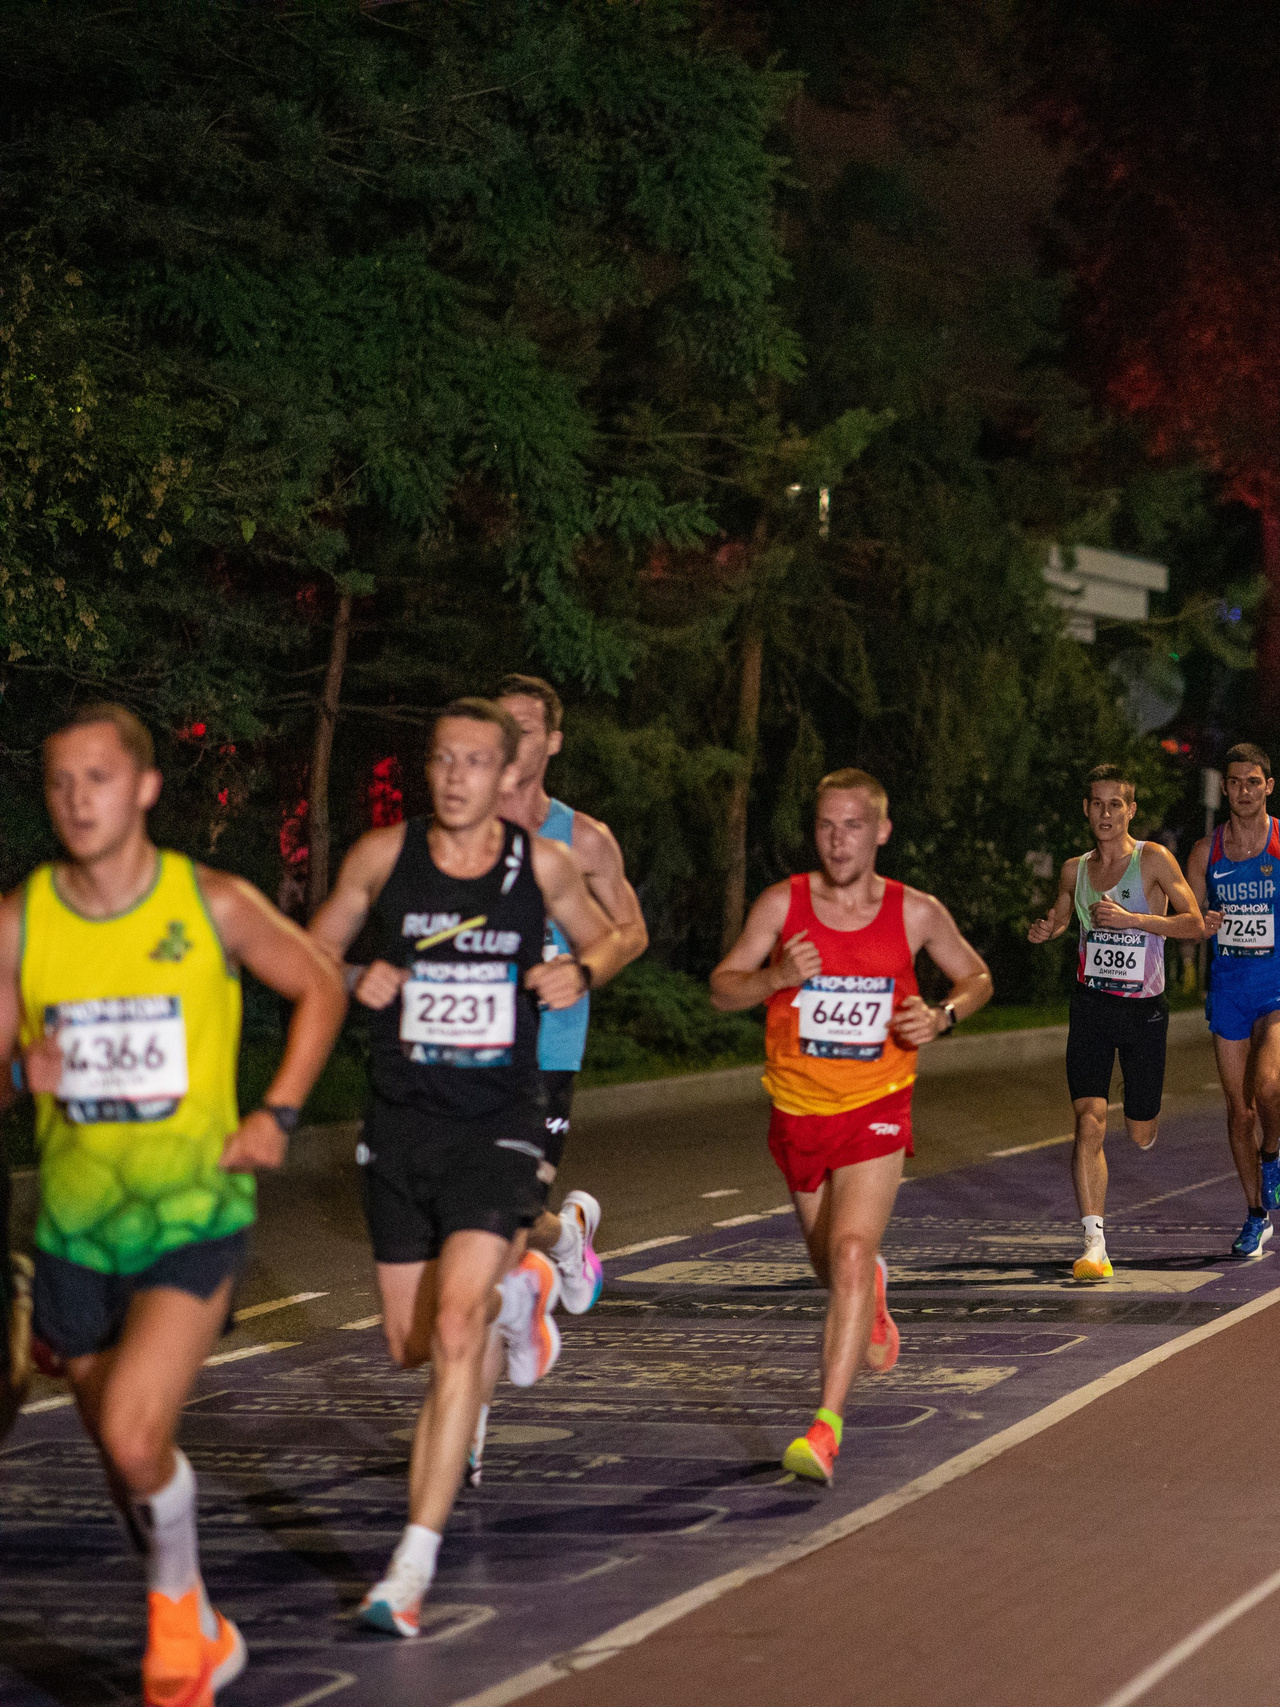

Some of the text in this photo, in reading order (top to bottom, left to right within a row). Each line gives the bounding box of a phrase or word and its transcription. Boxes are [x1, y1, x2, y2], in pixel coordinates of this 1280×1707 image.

[1217, 880, 1276, 901] RUSSIA
[402, 912, 461, 938] RUN
[1223, 919, 1267, 936] 7245
[453, 930, 522, 955] CLUB
[1093, 948, 1137, 970] 6386
[1098, 967, 1127, 976] ДМИТРИЙ
[418, 993, 496, 1024] 2231
[813, 1000, 881, 1026] 6467
